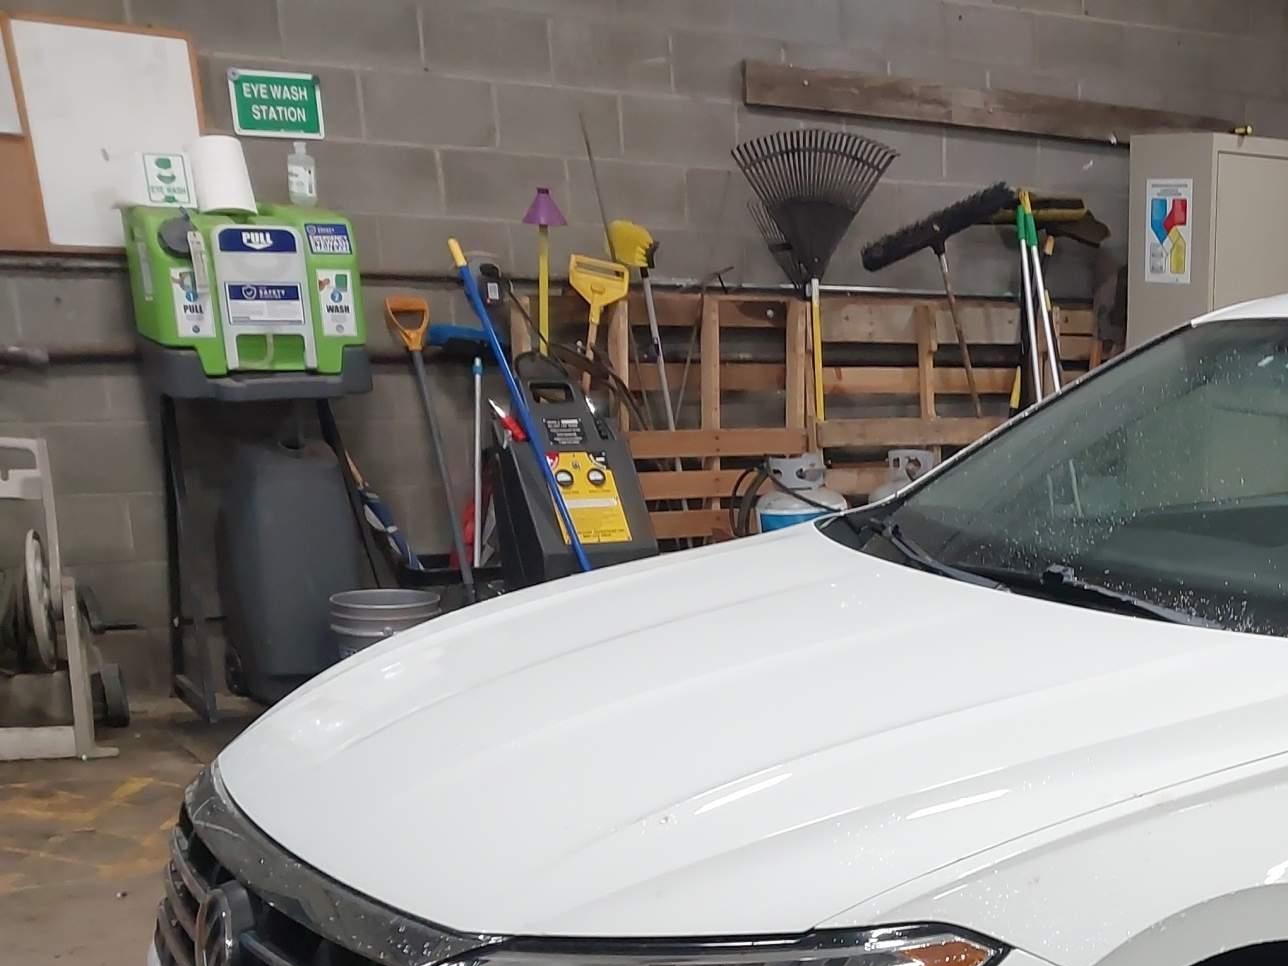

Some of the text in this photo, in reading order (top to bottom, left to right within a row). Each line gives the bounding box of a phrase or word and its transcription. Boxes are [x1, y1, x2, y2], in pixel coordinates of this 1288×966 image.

[242, 82, 308, 101] EYE WASH
[251, 104, 307, 122] STATION
[241, 231, 273, 245] PULL
[183, 304, 204, 314] PULL
[326, 304, 351, 314] WASH
